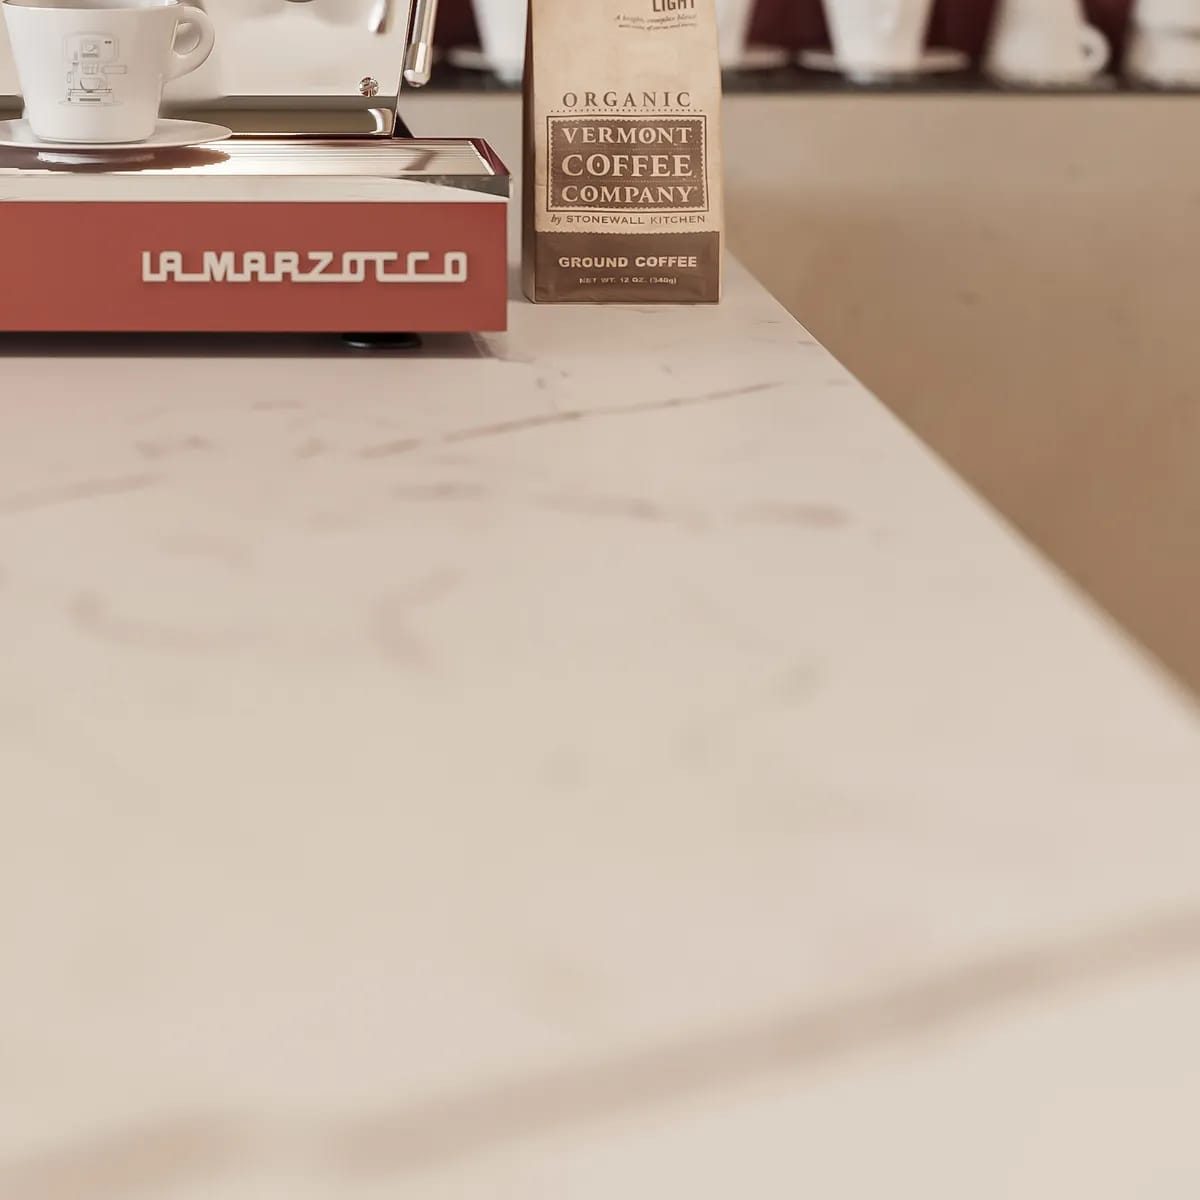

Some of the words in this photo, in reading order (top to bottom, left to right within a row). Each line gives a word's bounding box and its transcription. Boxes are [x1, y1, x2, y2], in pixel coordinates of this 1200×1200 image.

[562, 91, 691, 107] ORGANIC
[561, 127, 692, 144] VERMONT
[561, 153, 693, 177] COFFEE
[561, 185, 693, 203] COMPANY
[551, 214, 562, 225] by
[566, 215, 645, 225] STONEWALL
[650, 215, 705, 225] KITCHEN
[558, 256, 629, 268] GROUND
[635, 256, 697, 268] COFFEE
